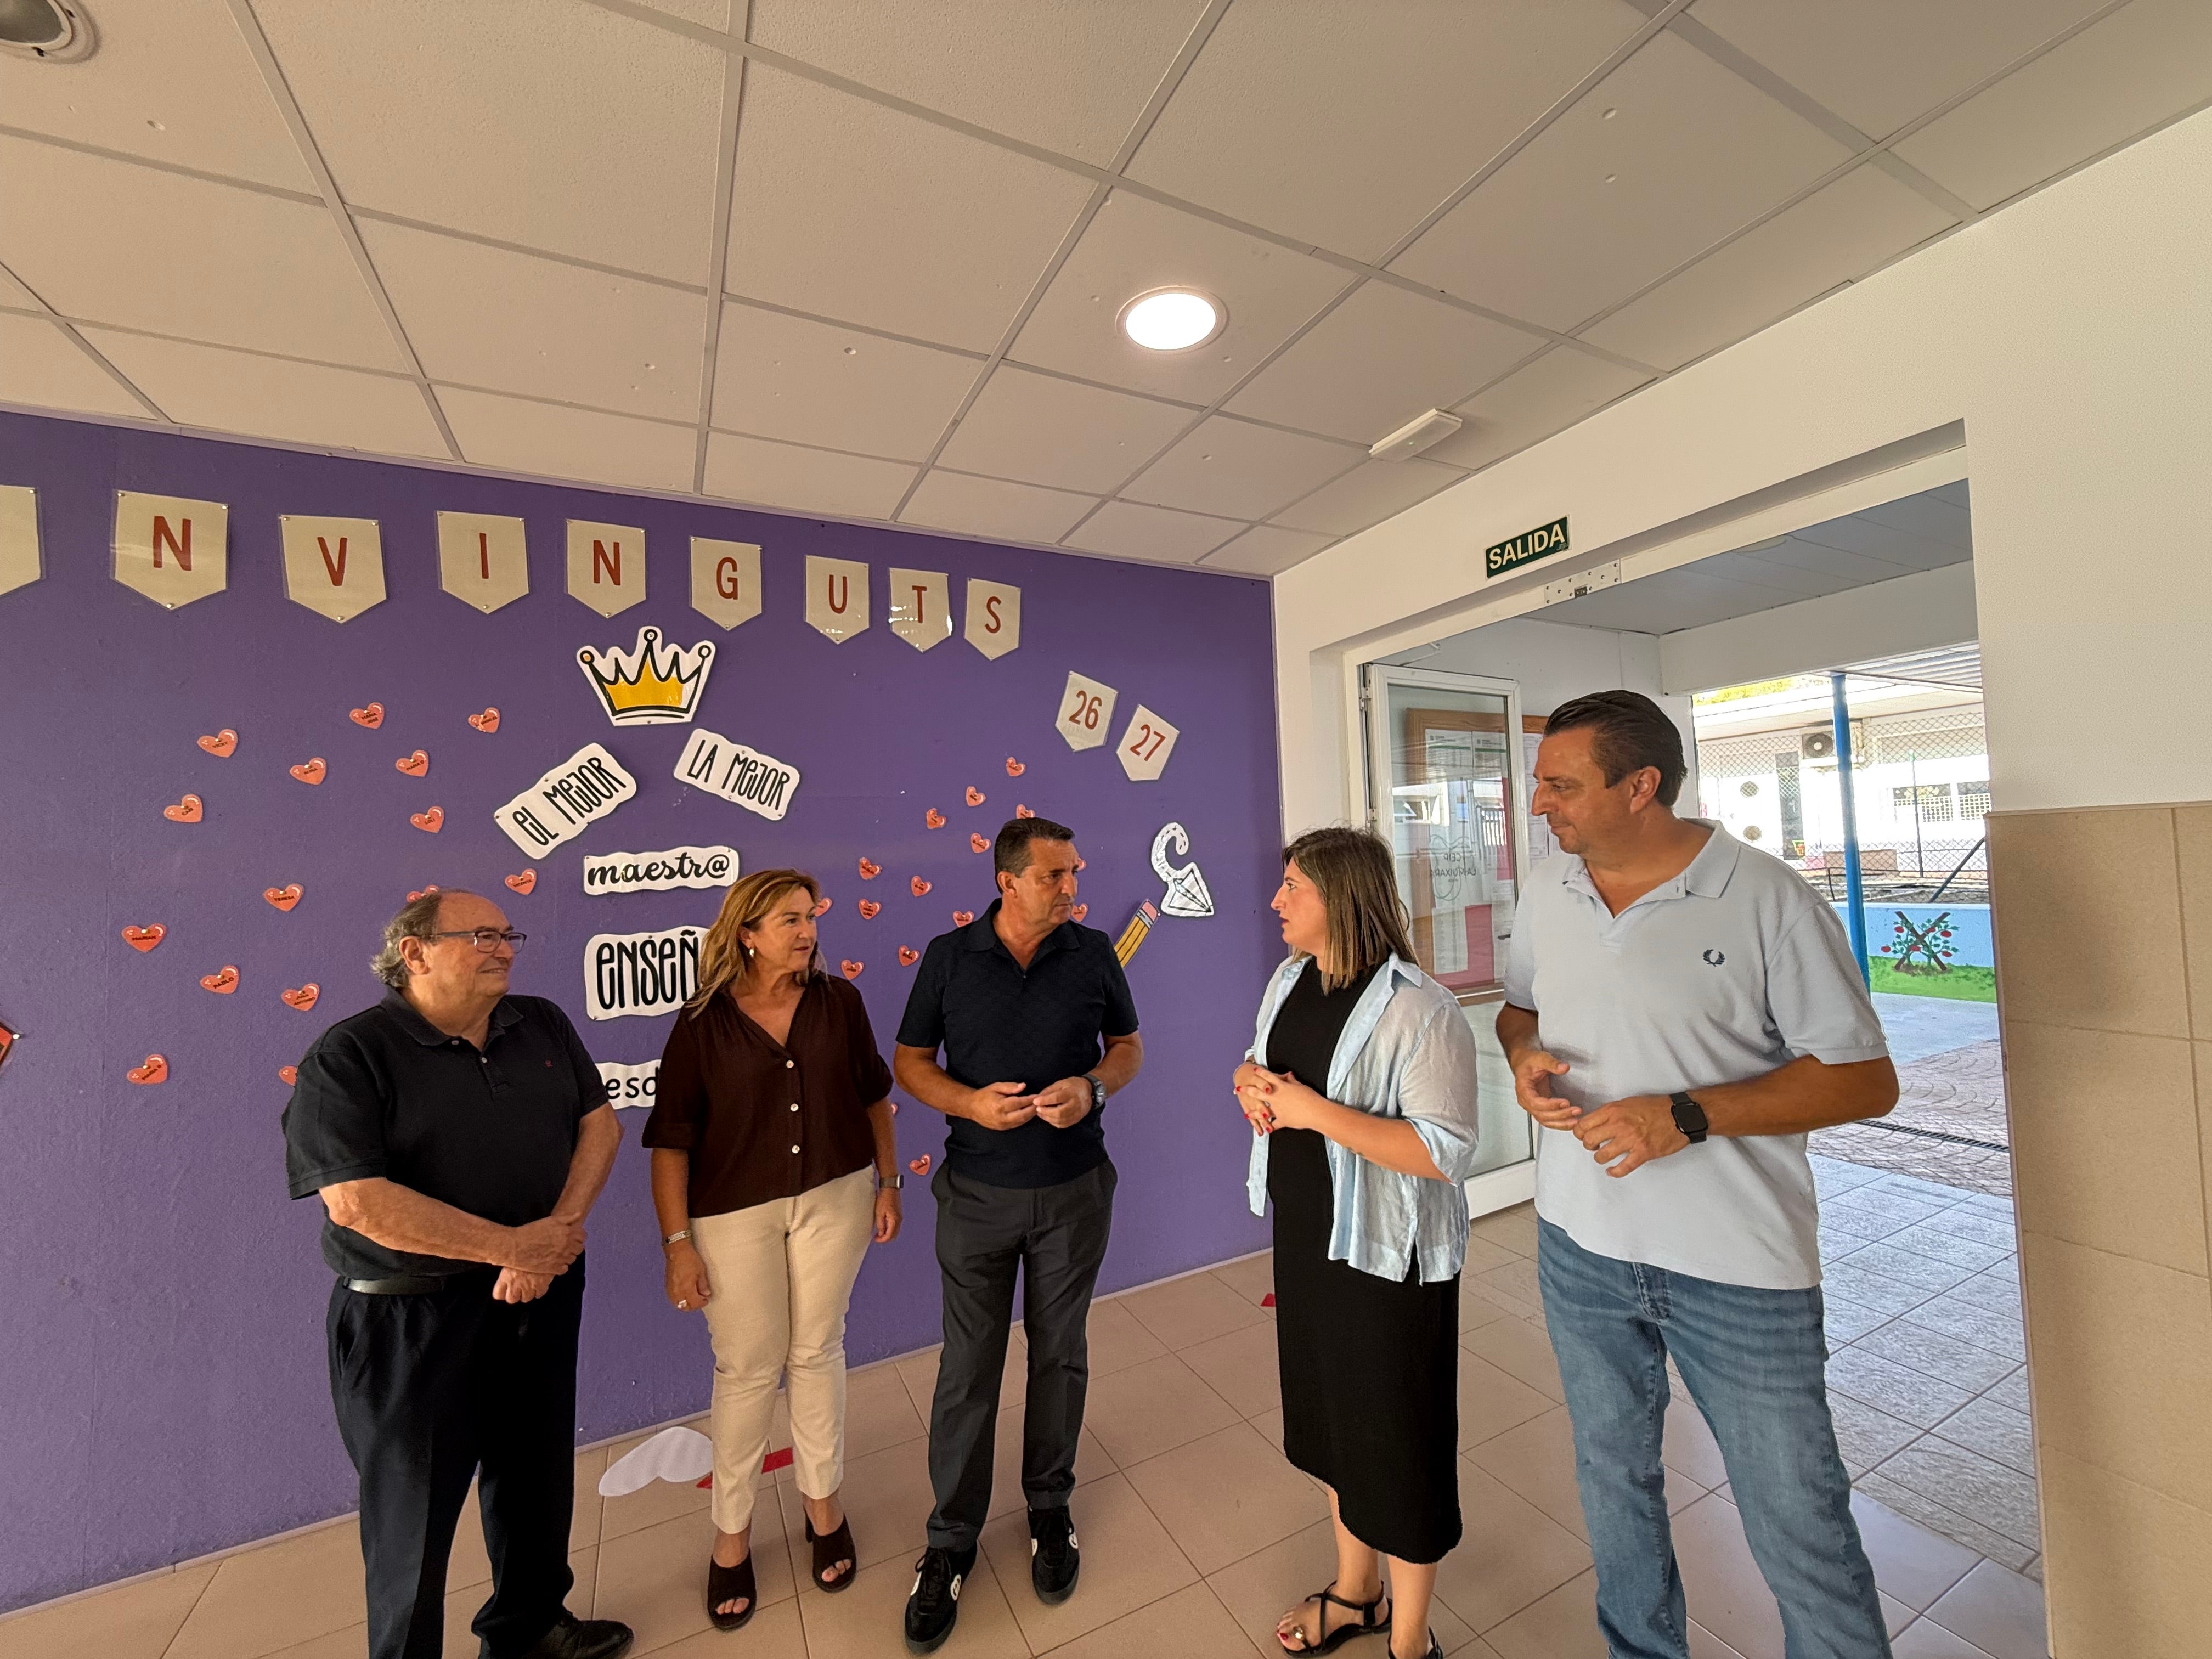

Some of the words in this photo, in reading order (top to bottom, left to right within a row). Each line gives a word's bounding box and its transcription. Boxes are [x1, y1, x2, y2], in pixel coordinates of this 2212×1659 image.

[1489, 523, 1565, 569] SALIDA
[1069, 690, 1102, 730] 26
[687, 739, 718, 783] LA
[1130, 724, 1166, 761] 27
[588, 852, 730, 886] maestr@
[213, 977, 234, 989] PABLO
[294, 997, 316, 1006] ANTONIO
